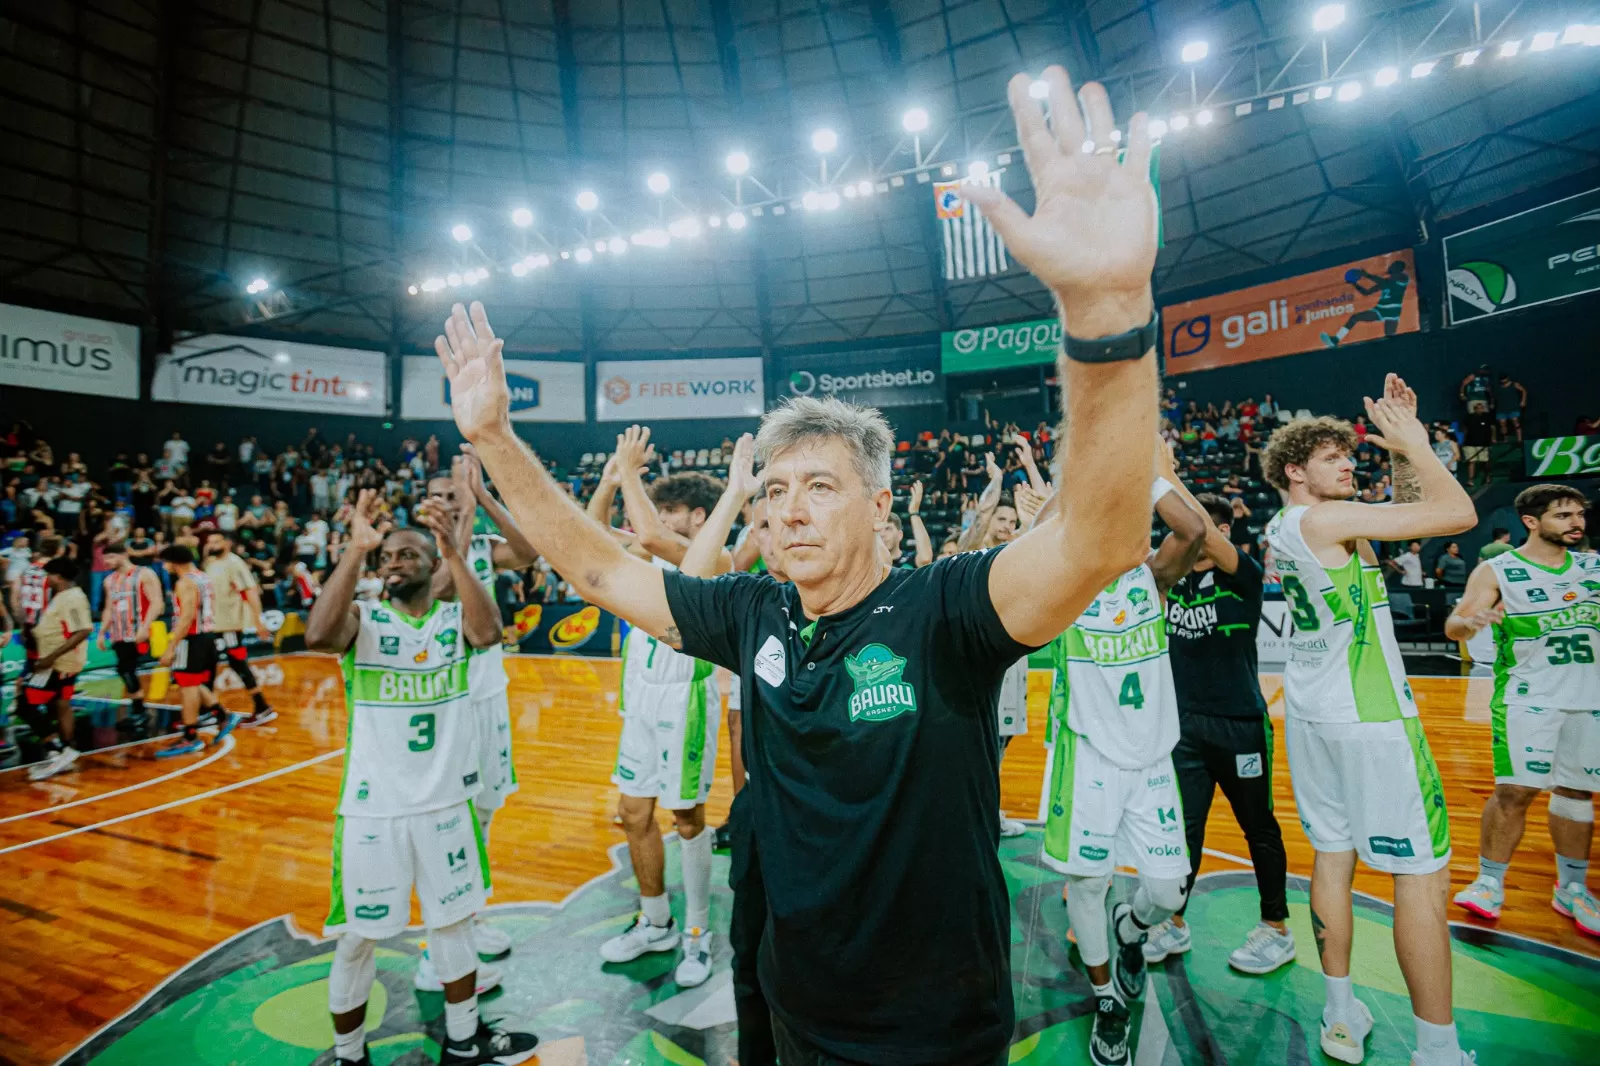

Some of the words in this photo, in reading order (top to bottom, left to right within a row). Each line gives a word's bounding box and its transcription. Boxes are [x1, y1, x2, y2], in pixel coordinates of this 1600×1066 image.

[1449, 277, 1484, 301] NALTY
[1221, 299, 1289, 349] gali
[639, 379, 757, 398] FIREWORK
[819, 368, 935, 393] Sportsbet.io
[1544, 633, 1595, 666] 35
[850, 684, 914, 717] BAURU
[1118, 671, 1145, 710] 4
[866, 705, 897, 717] BASKET
[408, 713, 436, 753] 3
[1146, 844, 1181, 857] voke
